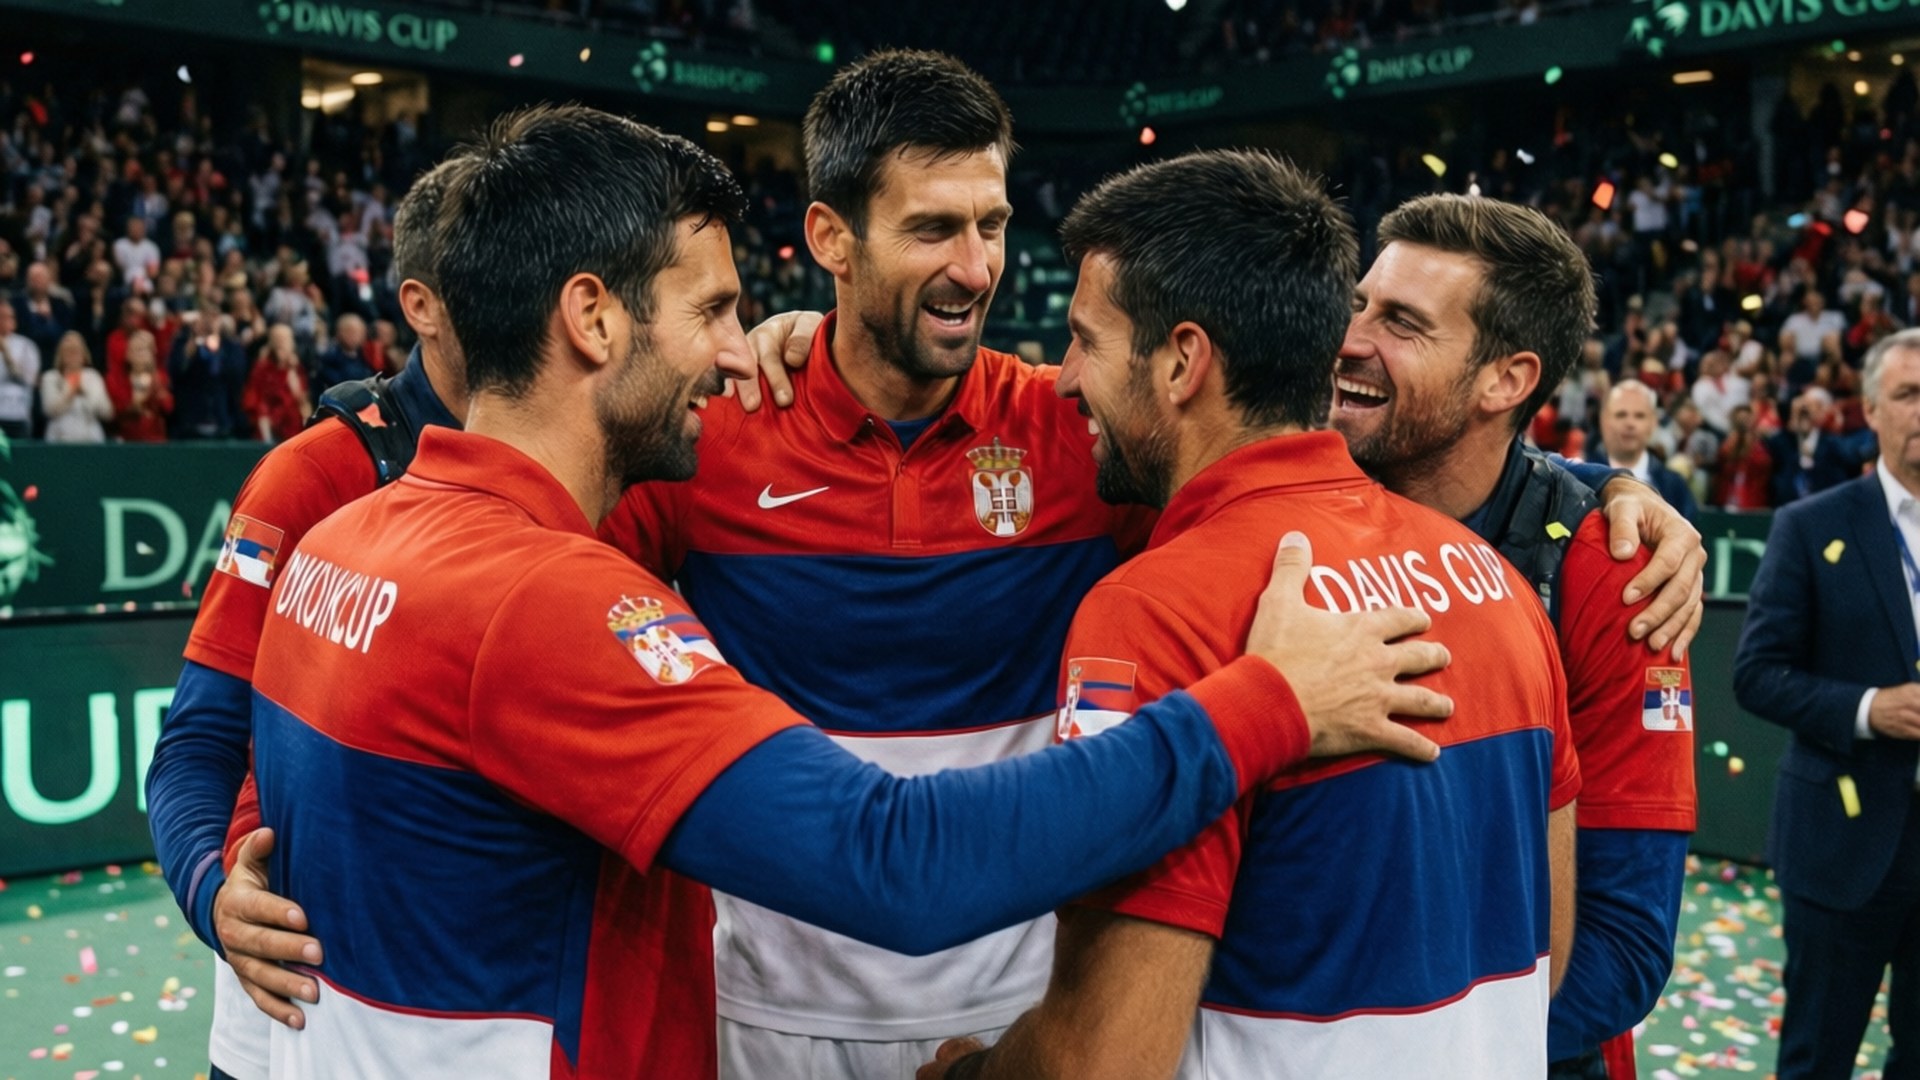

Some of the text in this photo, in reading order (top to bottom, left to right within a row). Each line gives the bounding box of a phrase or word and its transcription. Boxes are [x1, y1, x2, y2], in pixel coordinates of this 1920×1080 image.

[293, 1, 459, 52] DAVIS CUP
[1700, 0, 1823, 38] DAVIS
[1309, 535, 1514, 614] DAVIS CUP
